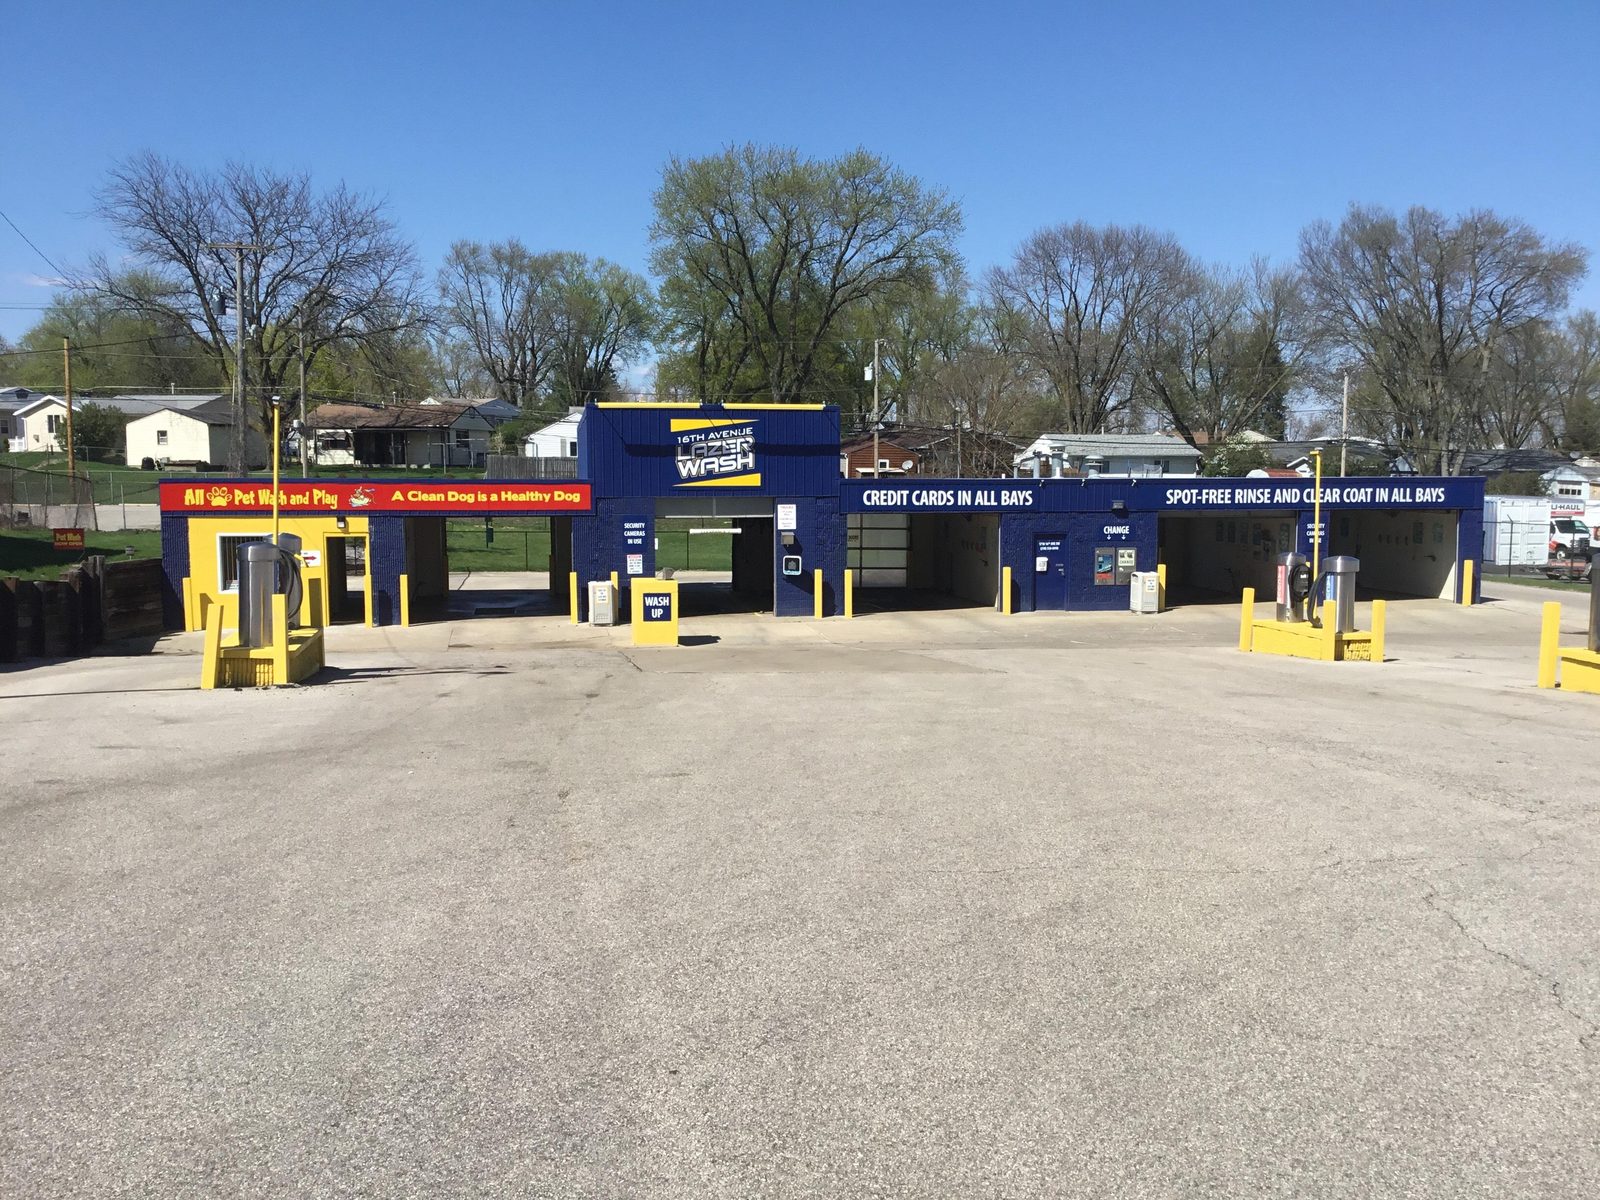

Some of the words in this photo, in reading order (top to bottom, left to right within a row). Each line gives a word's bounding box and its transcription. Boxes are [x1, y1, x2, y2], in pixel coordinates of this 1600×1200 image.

[677, 433, 705, 444] 16TH
[708, 427, 753, 440] AVENUE
[676, 436, 755, 461] LAZER
[675, 452, 755, 479] WASH
[184, 488, 204, 506] All
[234, 488, 255, 506] Pet
[289, 491, 309, 506] and
[312, 488, 338, 510] Play
[391, 490, 404, 502] A
[407, 490, 445, 502] Clean
[447, 490, 475, 503] Dog
[477, 490, 488, 502] is
[490, 493, 498, 502] a
[501, 490, 551, 503] Healthy
[553, 490, 581, 503] Dog
[863, 490, 909, 506] CREDIT
[911, 490, 954, 506] CARDS
[957, 490, 972, 506] IN
[974, 490, 998, 506] ALL
[1000, 490, 1033, 506] BAYS
[1166, 489, 1232, 505] SPOT-FREE
[1234, 488, 1271, 504] RINSE
[1273, 488, 1300, 504] AND
[1343, 487, 1373, 503] COAT
[1375, 487, 1389, 503] IN
[1391, 487, 1413, 503] ALL
[1415, 487, 1445, 503] BAYS
[1103, 525, 1130, 535] CHANGE
[644, 596, 670, 607] WASH
[651, 608, 663, 618] UP
